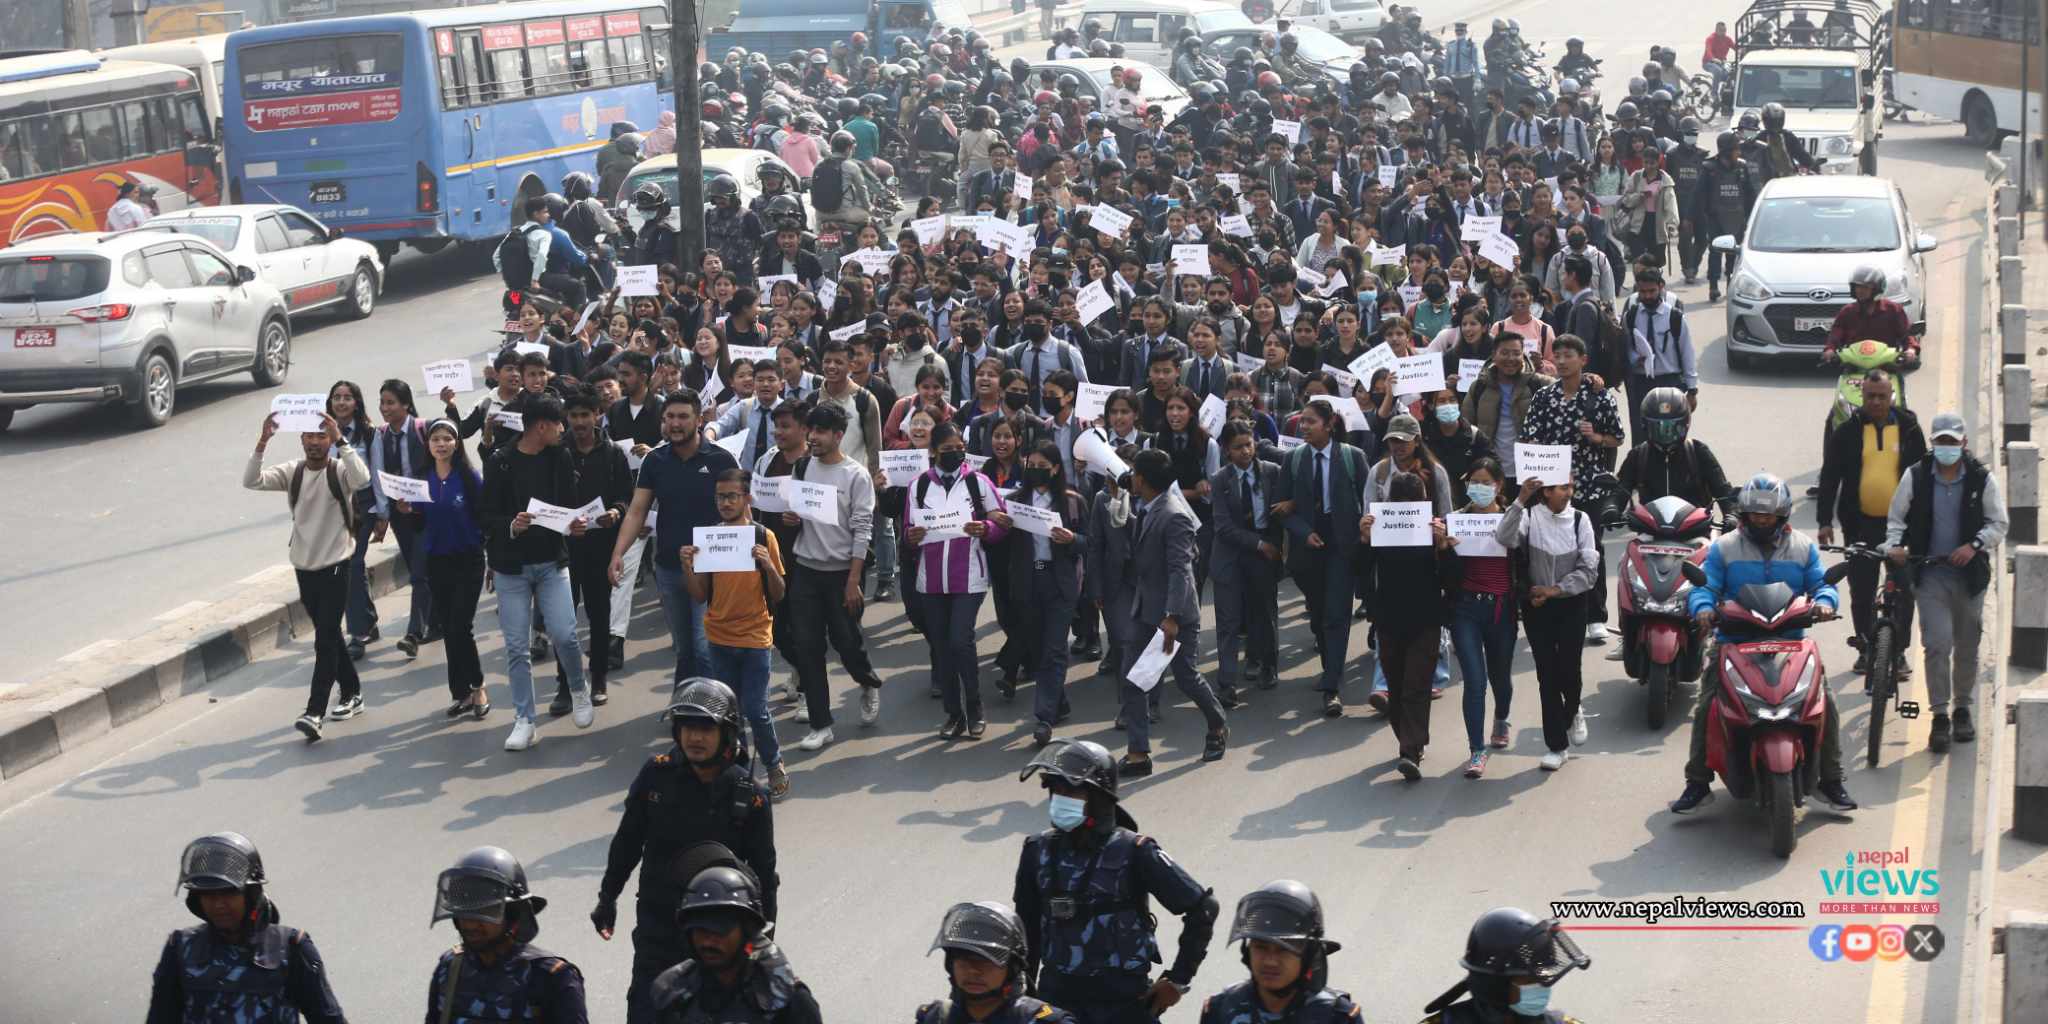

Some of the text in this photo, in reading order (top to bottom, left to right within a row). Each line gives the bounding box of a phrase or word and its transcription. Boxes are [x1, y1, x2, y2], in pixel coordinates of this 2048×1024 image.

[261, 73, 386, 92] मयूर यातायात
[328, 101, 360, 112] move
[1413, 359, 1432, 367] want
[1523, 450, 1560, 459] We want
[939, 510, 960, 520] want
[1398, 508, 1420, 516] want
[716, 532, 738, 540] प्रशासन
